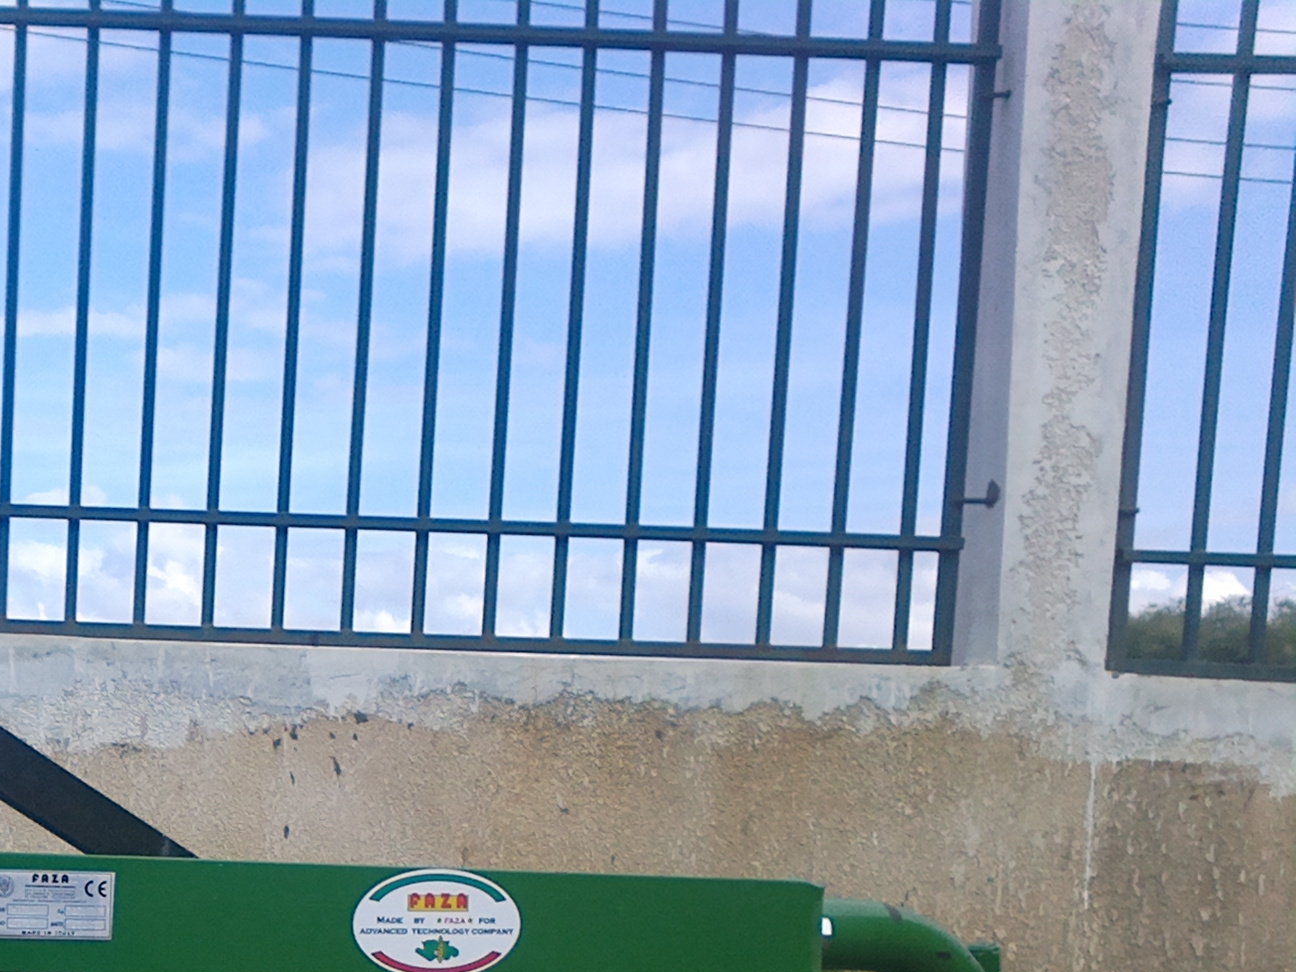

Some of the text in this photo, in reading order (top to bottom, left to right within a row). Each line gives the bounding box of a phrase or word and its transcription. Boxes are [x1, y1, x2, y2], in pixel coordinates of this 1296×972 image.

[31, 874, 69, 883] FAZA
[84, 880, 107, 898] CE
[409, 892, 468, 909] FAZA
